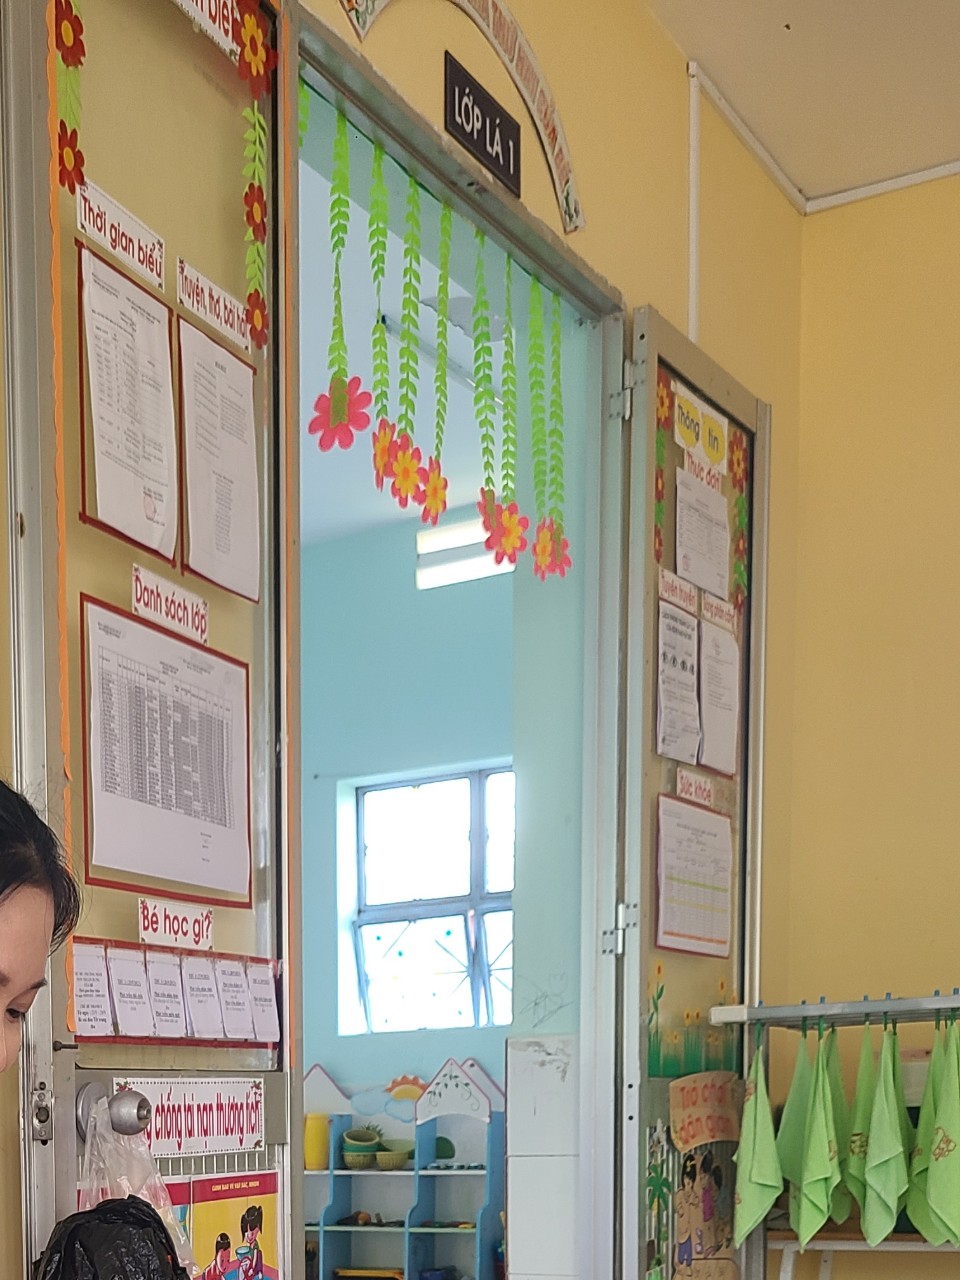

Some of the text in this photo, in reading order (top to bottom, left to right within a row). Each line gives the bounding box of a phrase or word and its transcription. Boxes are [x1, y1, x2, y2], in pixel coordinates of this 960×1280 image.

[454, 86, 515, 175] LỚP LÁ 1
[81, 193, 162, 279] Thời gian biểu
[179, 272, 207, 315] Truyện,
[208, 287, 223, 326] thơ,
[223, 297, 236, 331] bài
[677, 403, 719, 453] Thông tin
[134, 575, 208, 638] Danh sách lớp
[141, 902, 213, 945] Bé học gì?
[155, 1086, 182, 1152] chống
[183, 1093, 195, 1136] tai
[197, 1102, 215, 1149] nạn
[216, 1093, 244, 1147] thương
[245, 1086, 261, 1136] tích
